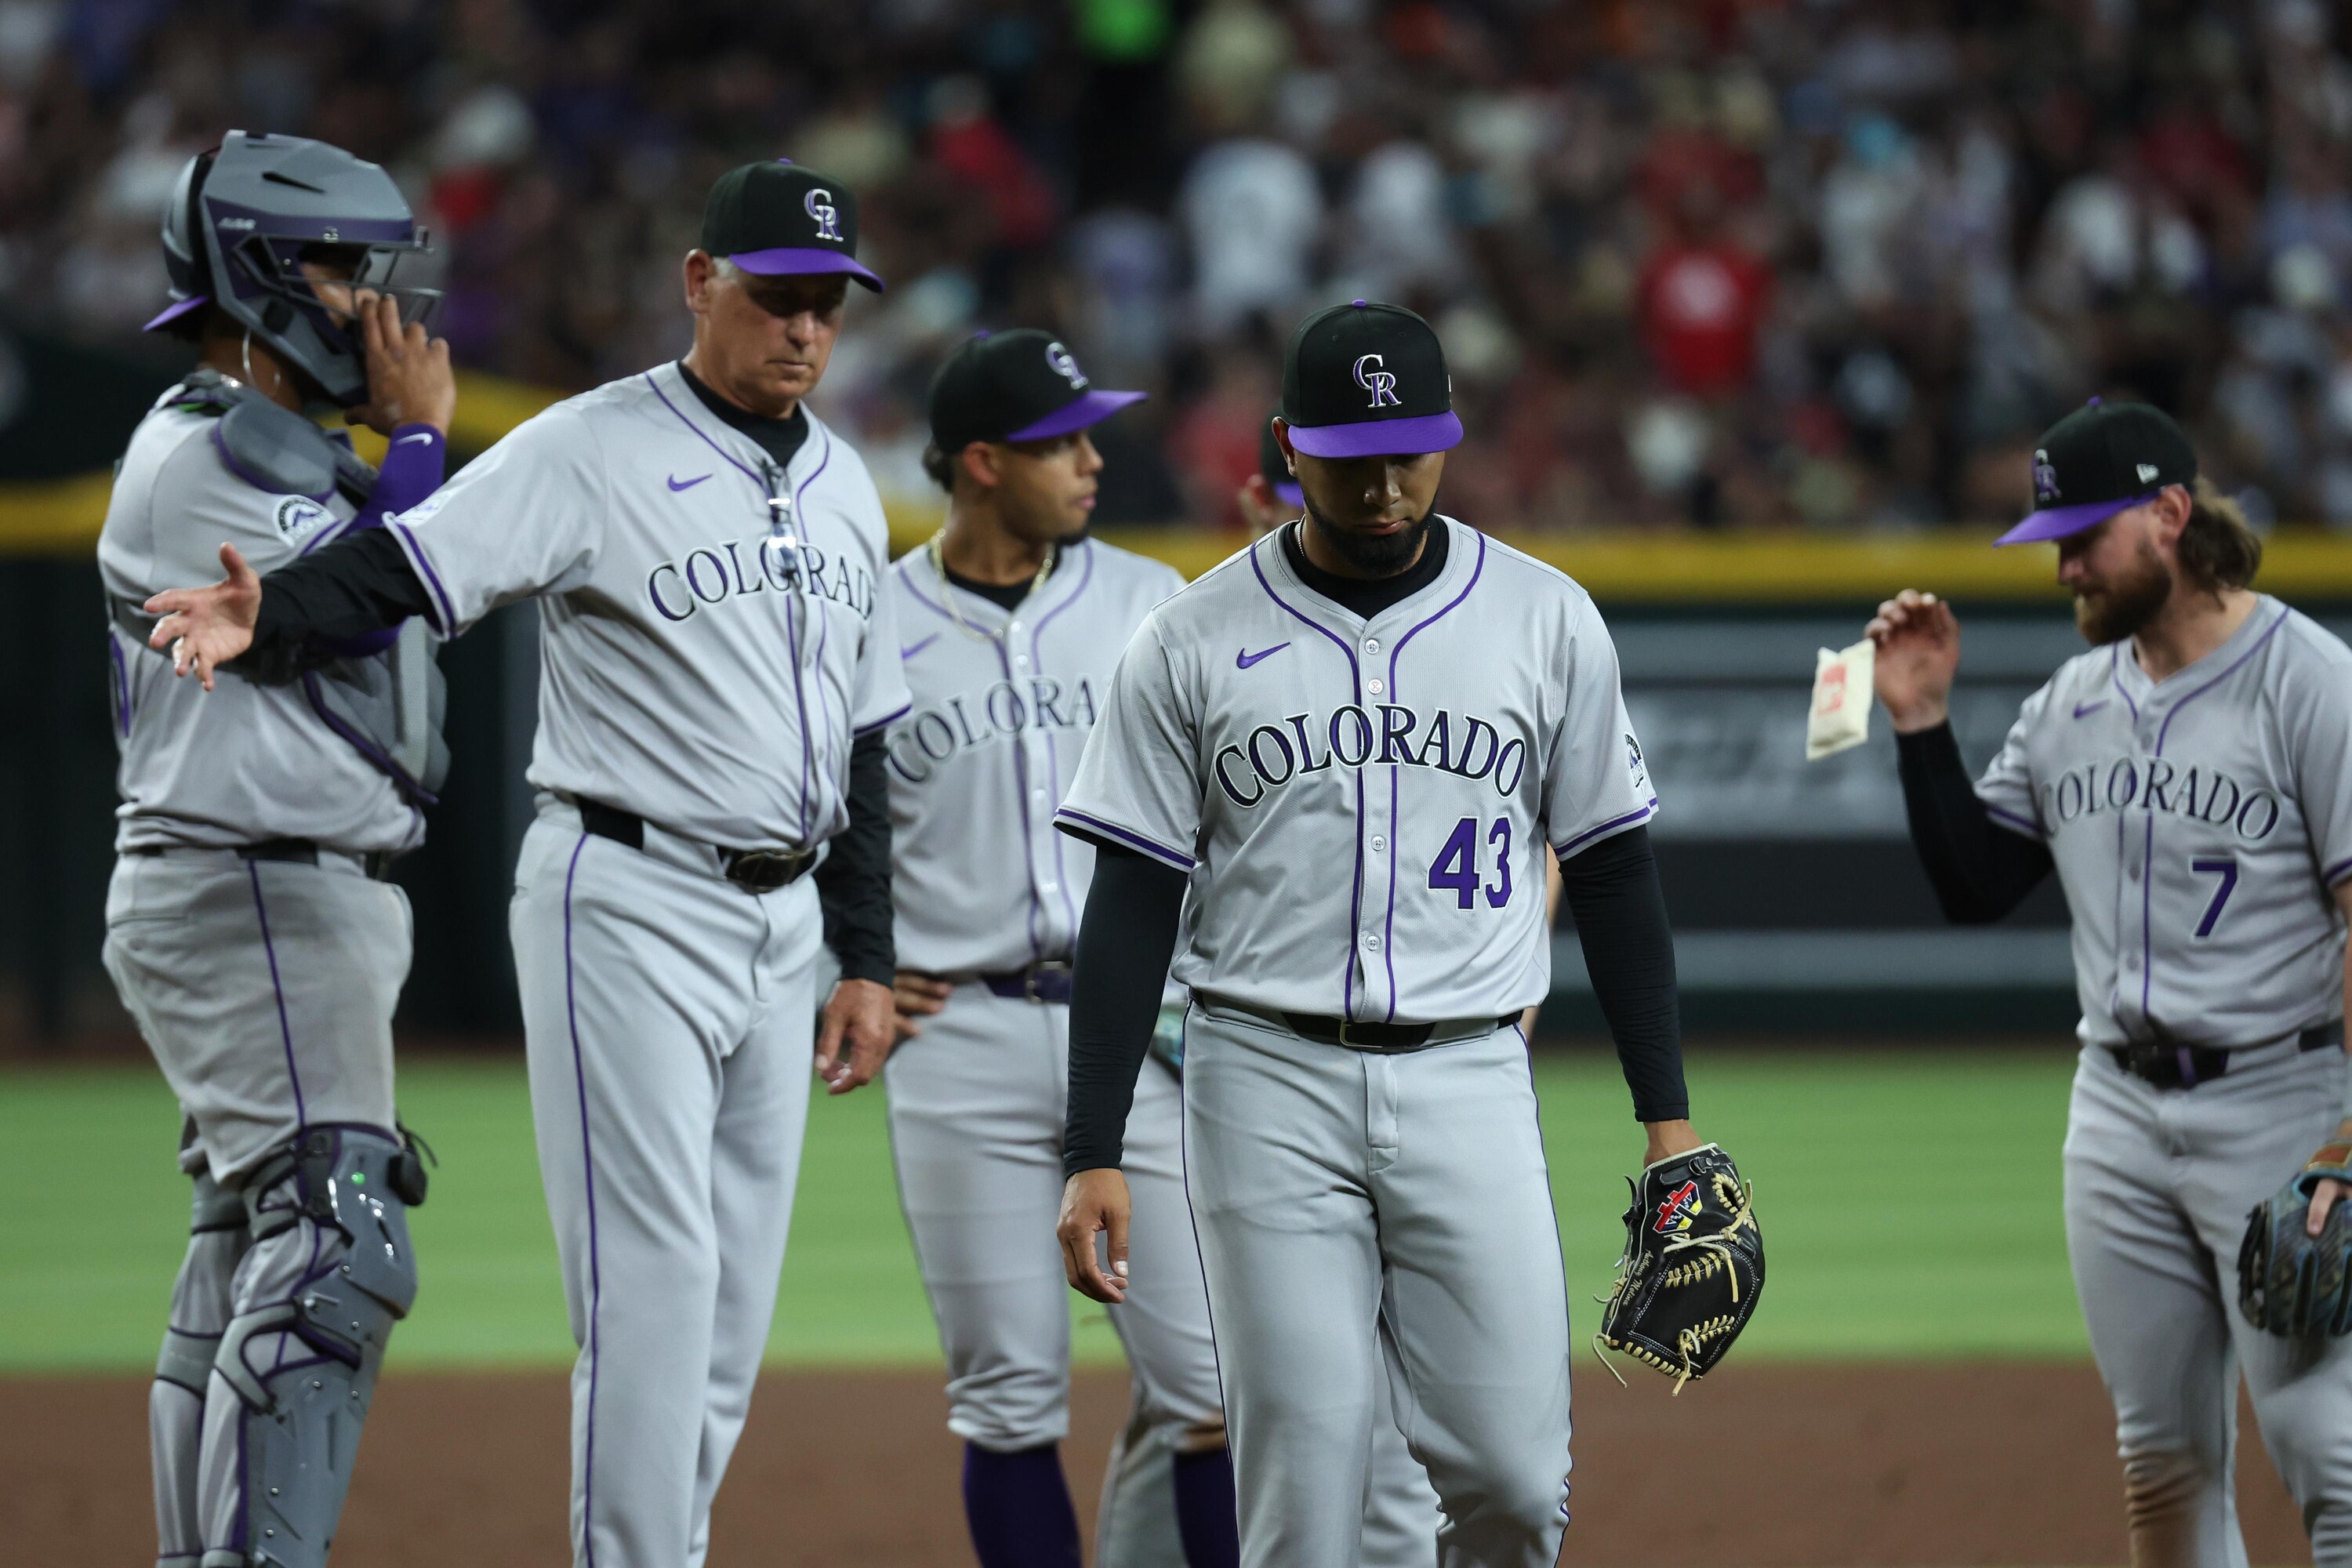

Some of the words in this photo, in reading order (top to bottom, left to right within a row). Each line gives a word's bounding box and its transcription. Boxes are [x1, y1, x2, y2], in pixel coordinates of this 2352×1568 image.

[804, 188, 844, 242] CR
[1353, 354, 1403, 408] CR
[647, 537, 875, 622] COLORAD
[887, 676, 1097, 784] COLORA
[1214, 703, 1526, 808] COLORADO
[2040, 757, 2279, 843] COLORADO
[1428, 816, 1513, 910] 43
[2190, 856, 2238, 938] 7
